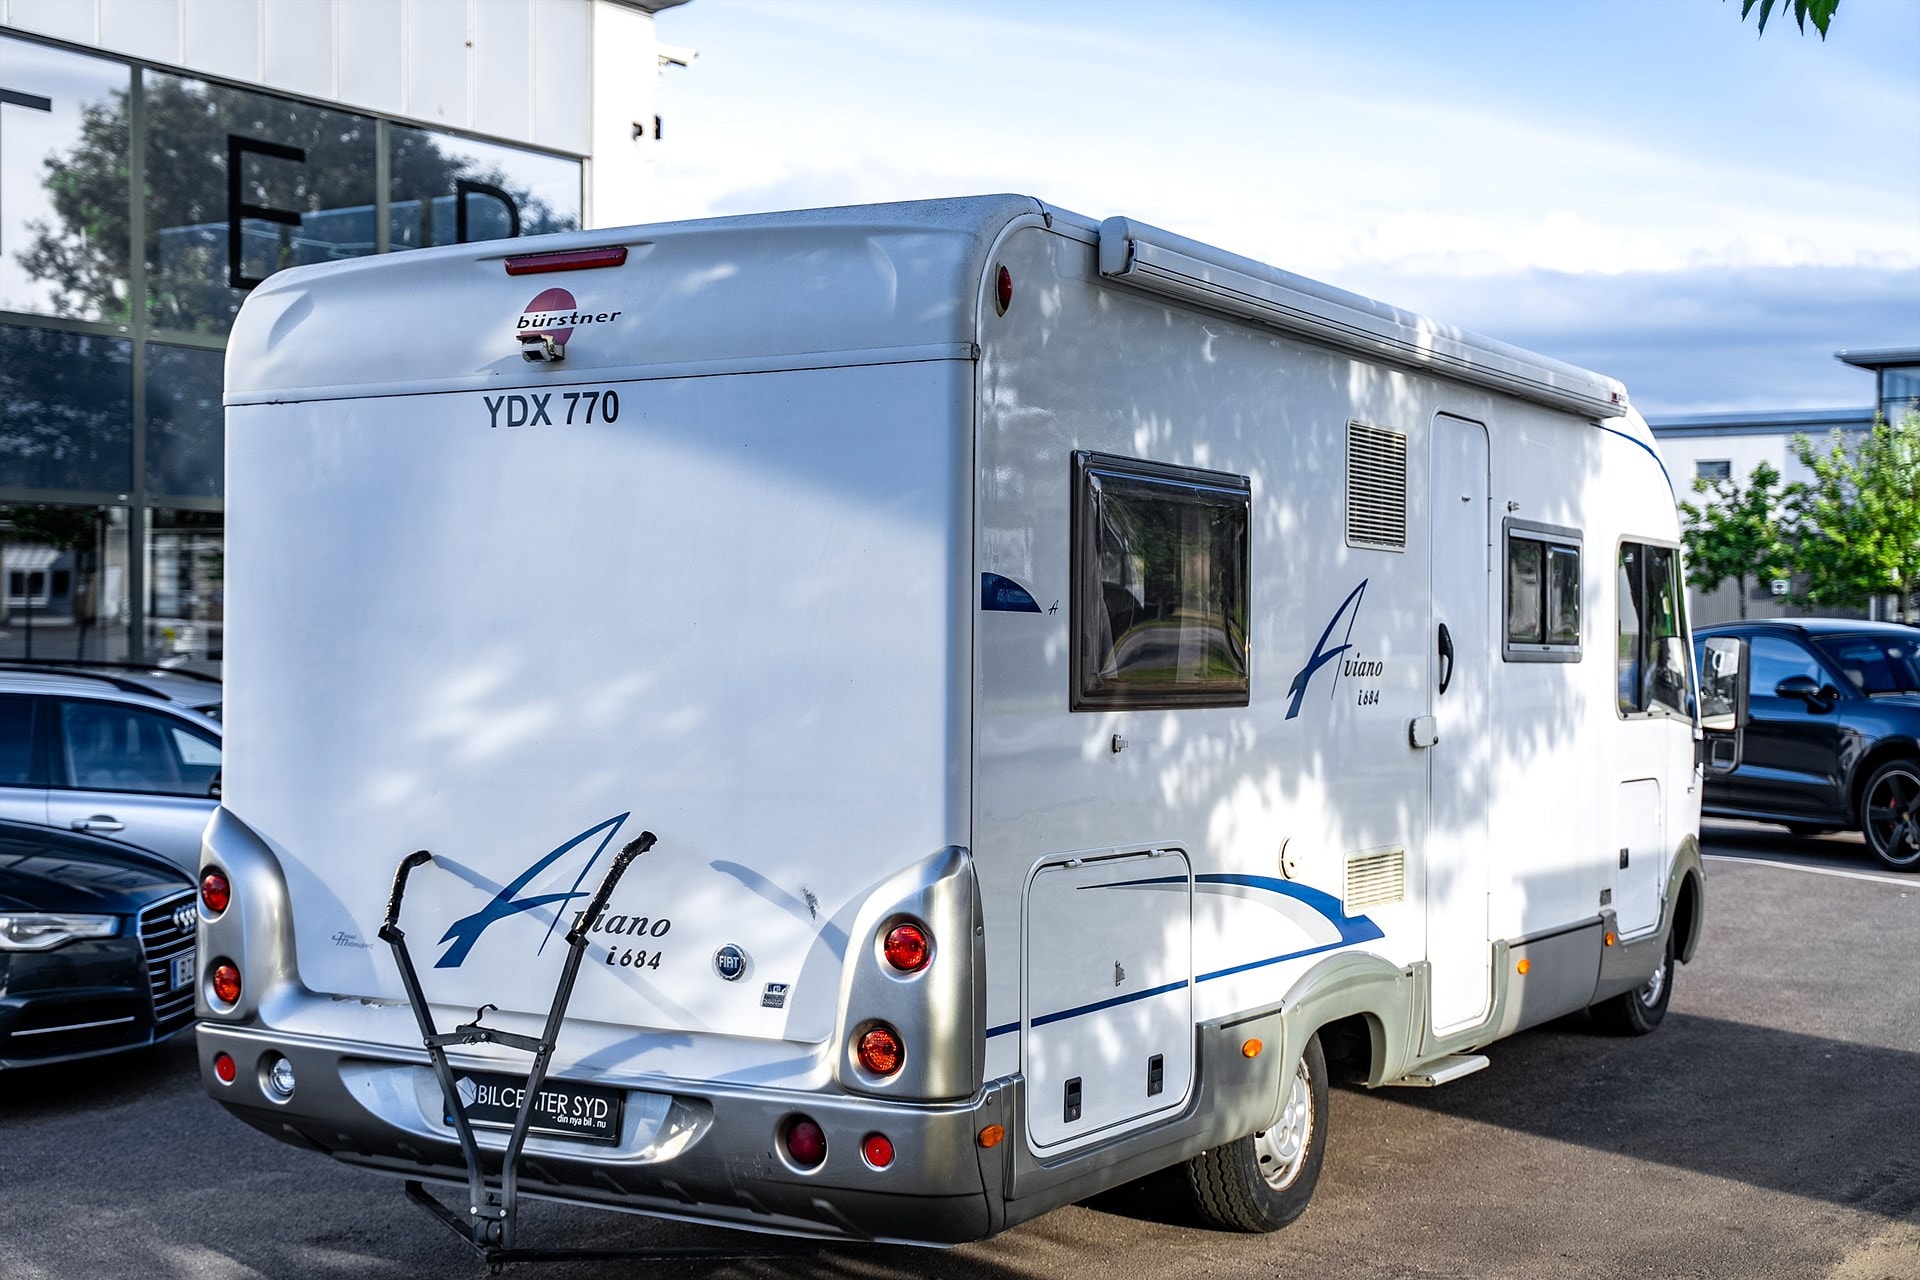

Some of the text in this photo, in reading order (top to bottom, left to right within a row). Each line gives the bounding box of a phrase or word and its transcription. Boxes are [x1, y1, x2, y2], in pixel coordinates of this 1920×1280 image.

[516, 311, 622, 329] bürstner
[483, 390, 619, 428] YDX 770
[1285, 578, 1383, 720] Aviano
[1358, 689, 1379, 706] i684
[605, 946, 663, 970] i684
[719, 955, 739, 969] FIAT
[478, 1085, 608, 1119] BILCETER SYD
[557, 1114, 568, 1123] din
[569, 1117, 582, 1126] nya
